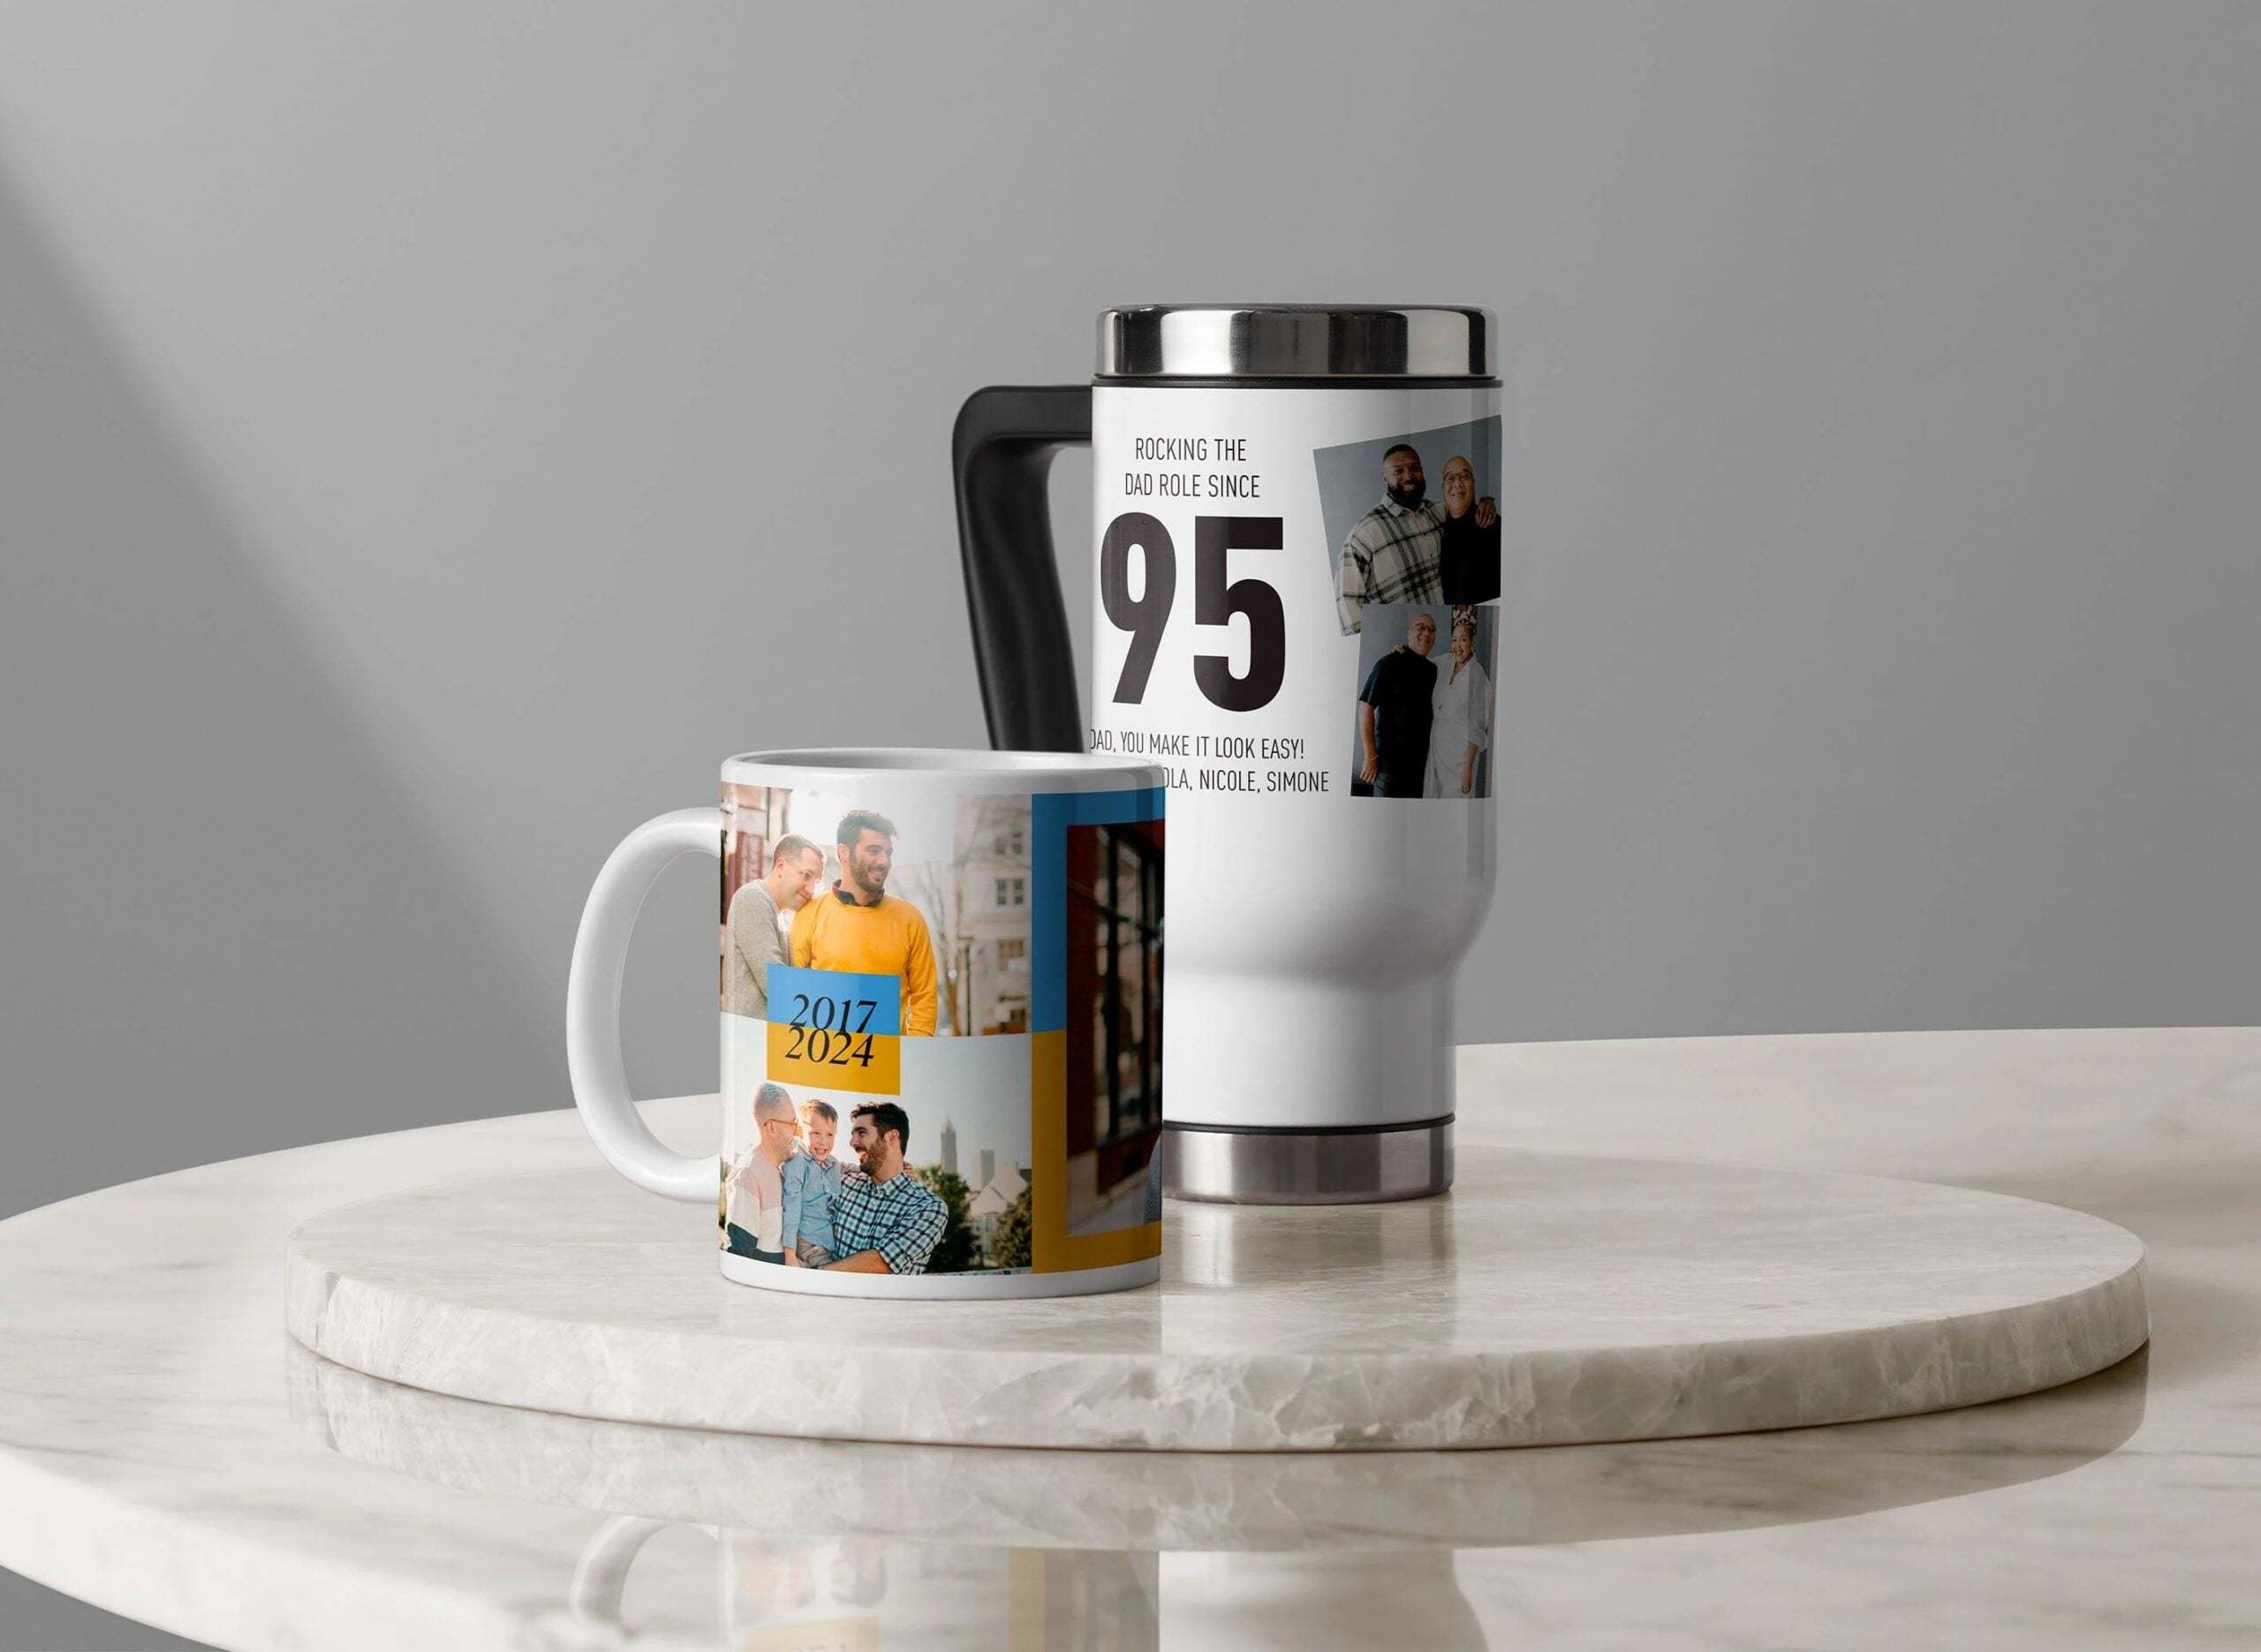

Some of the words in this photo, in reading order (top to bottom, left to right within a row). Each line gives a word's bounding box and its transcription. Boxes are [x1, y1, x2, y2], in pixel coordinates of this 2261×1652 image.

[1135, 437, 1207, 462] ROCKING
[1214, 438, 1247, 462] THE
[1124, 472, 1153, 496] DAD
[1159, 473, 1201, 497] ROLE
[1207, 473, 1260, 499] SINCE
[1100, 511, 1287, 713] 95
[1120, 731, 1145, 754] YOU
[1149, 733, 1190, 757] MAKE
[1196, 735, 1210, 758] IT
[1215, 736, 1256, 759] LOOK
[1261, 737, 1304, 760] EASY!
[1199, 768, 1261, 794] NICOLE,
[1267, 770, 1330, 793] SIMONE
[789, 994, 877, 1034] 2017
[784, 1026, 874, 1067] 2024
